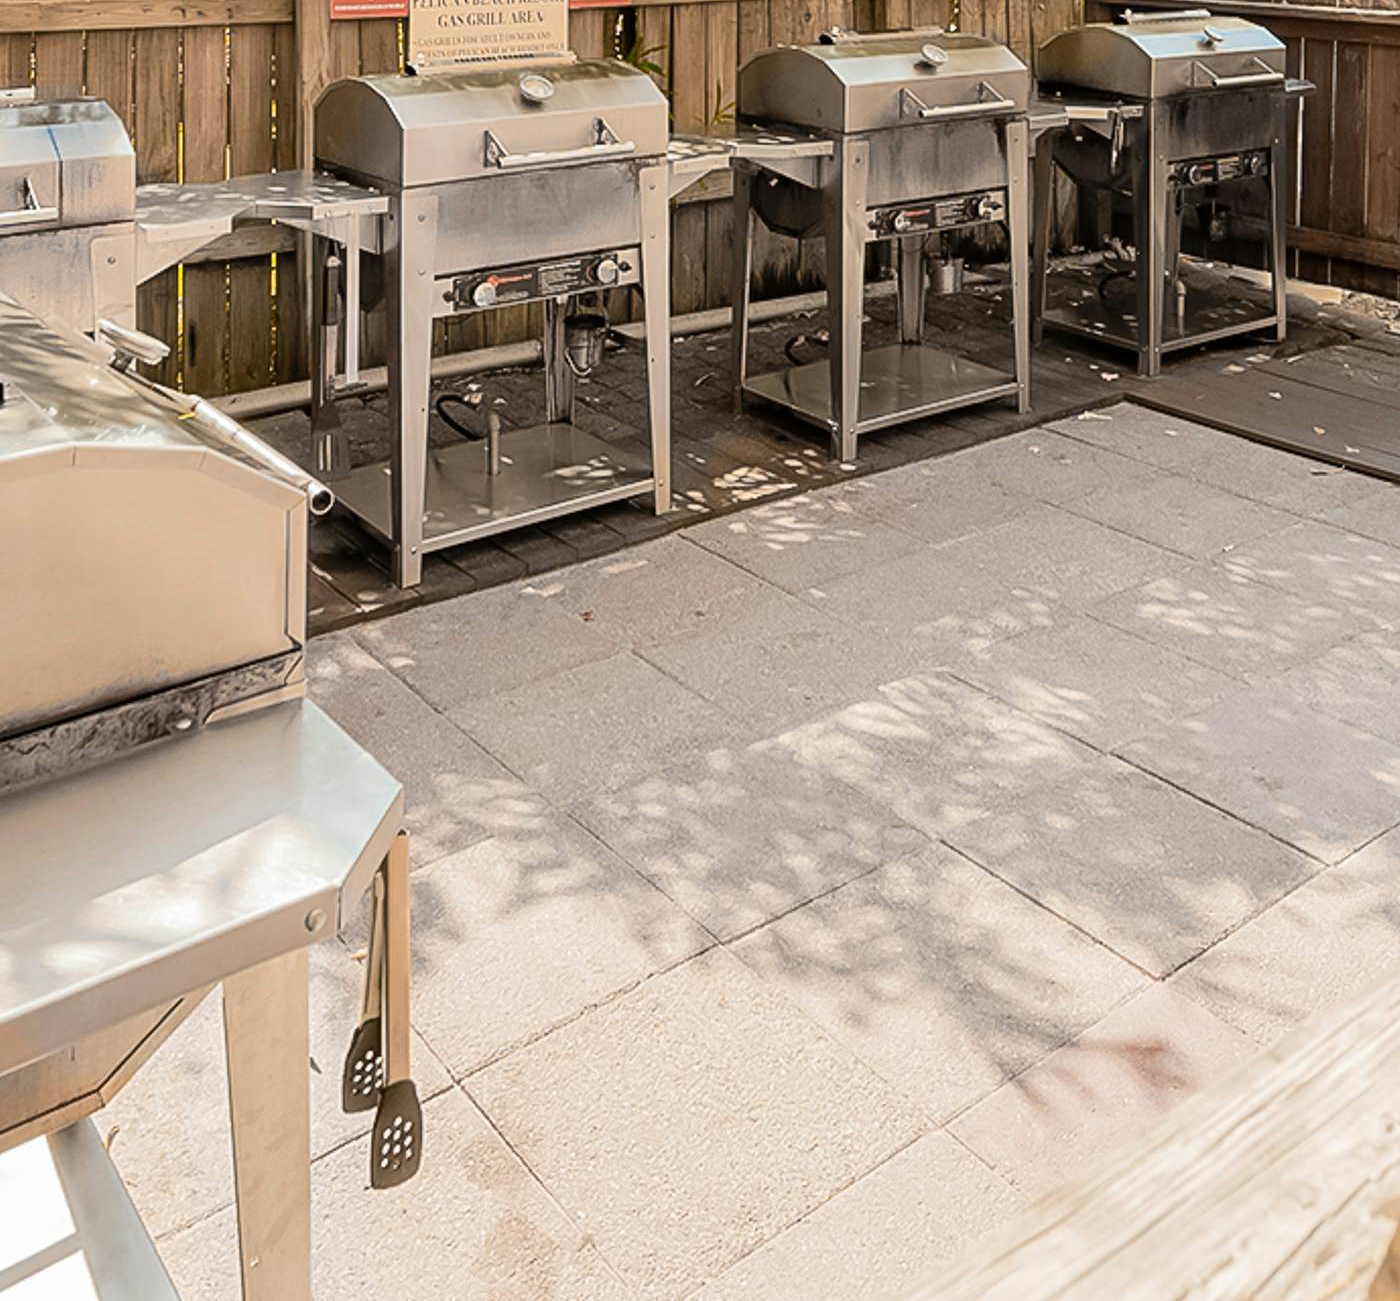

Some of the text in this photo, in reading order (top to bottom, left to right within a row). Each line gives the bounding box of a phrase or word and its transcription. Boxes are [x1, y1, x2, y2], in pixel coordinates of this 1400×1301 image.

[438, 10, 543, 28] GAS GRILL AREA
